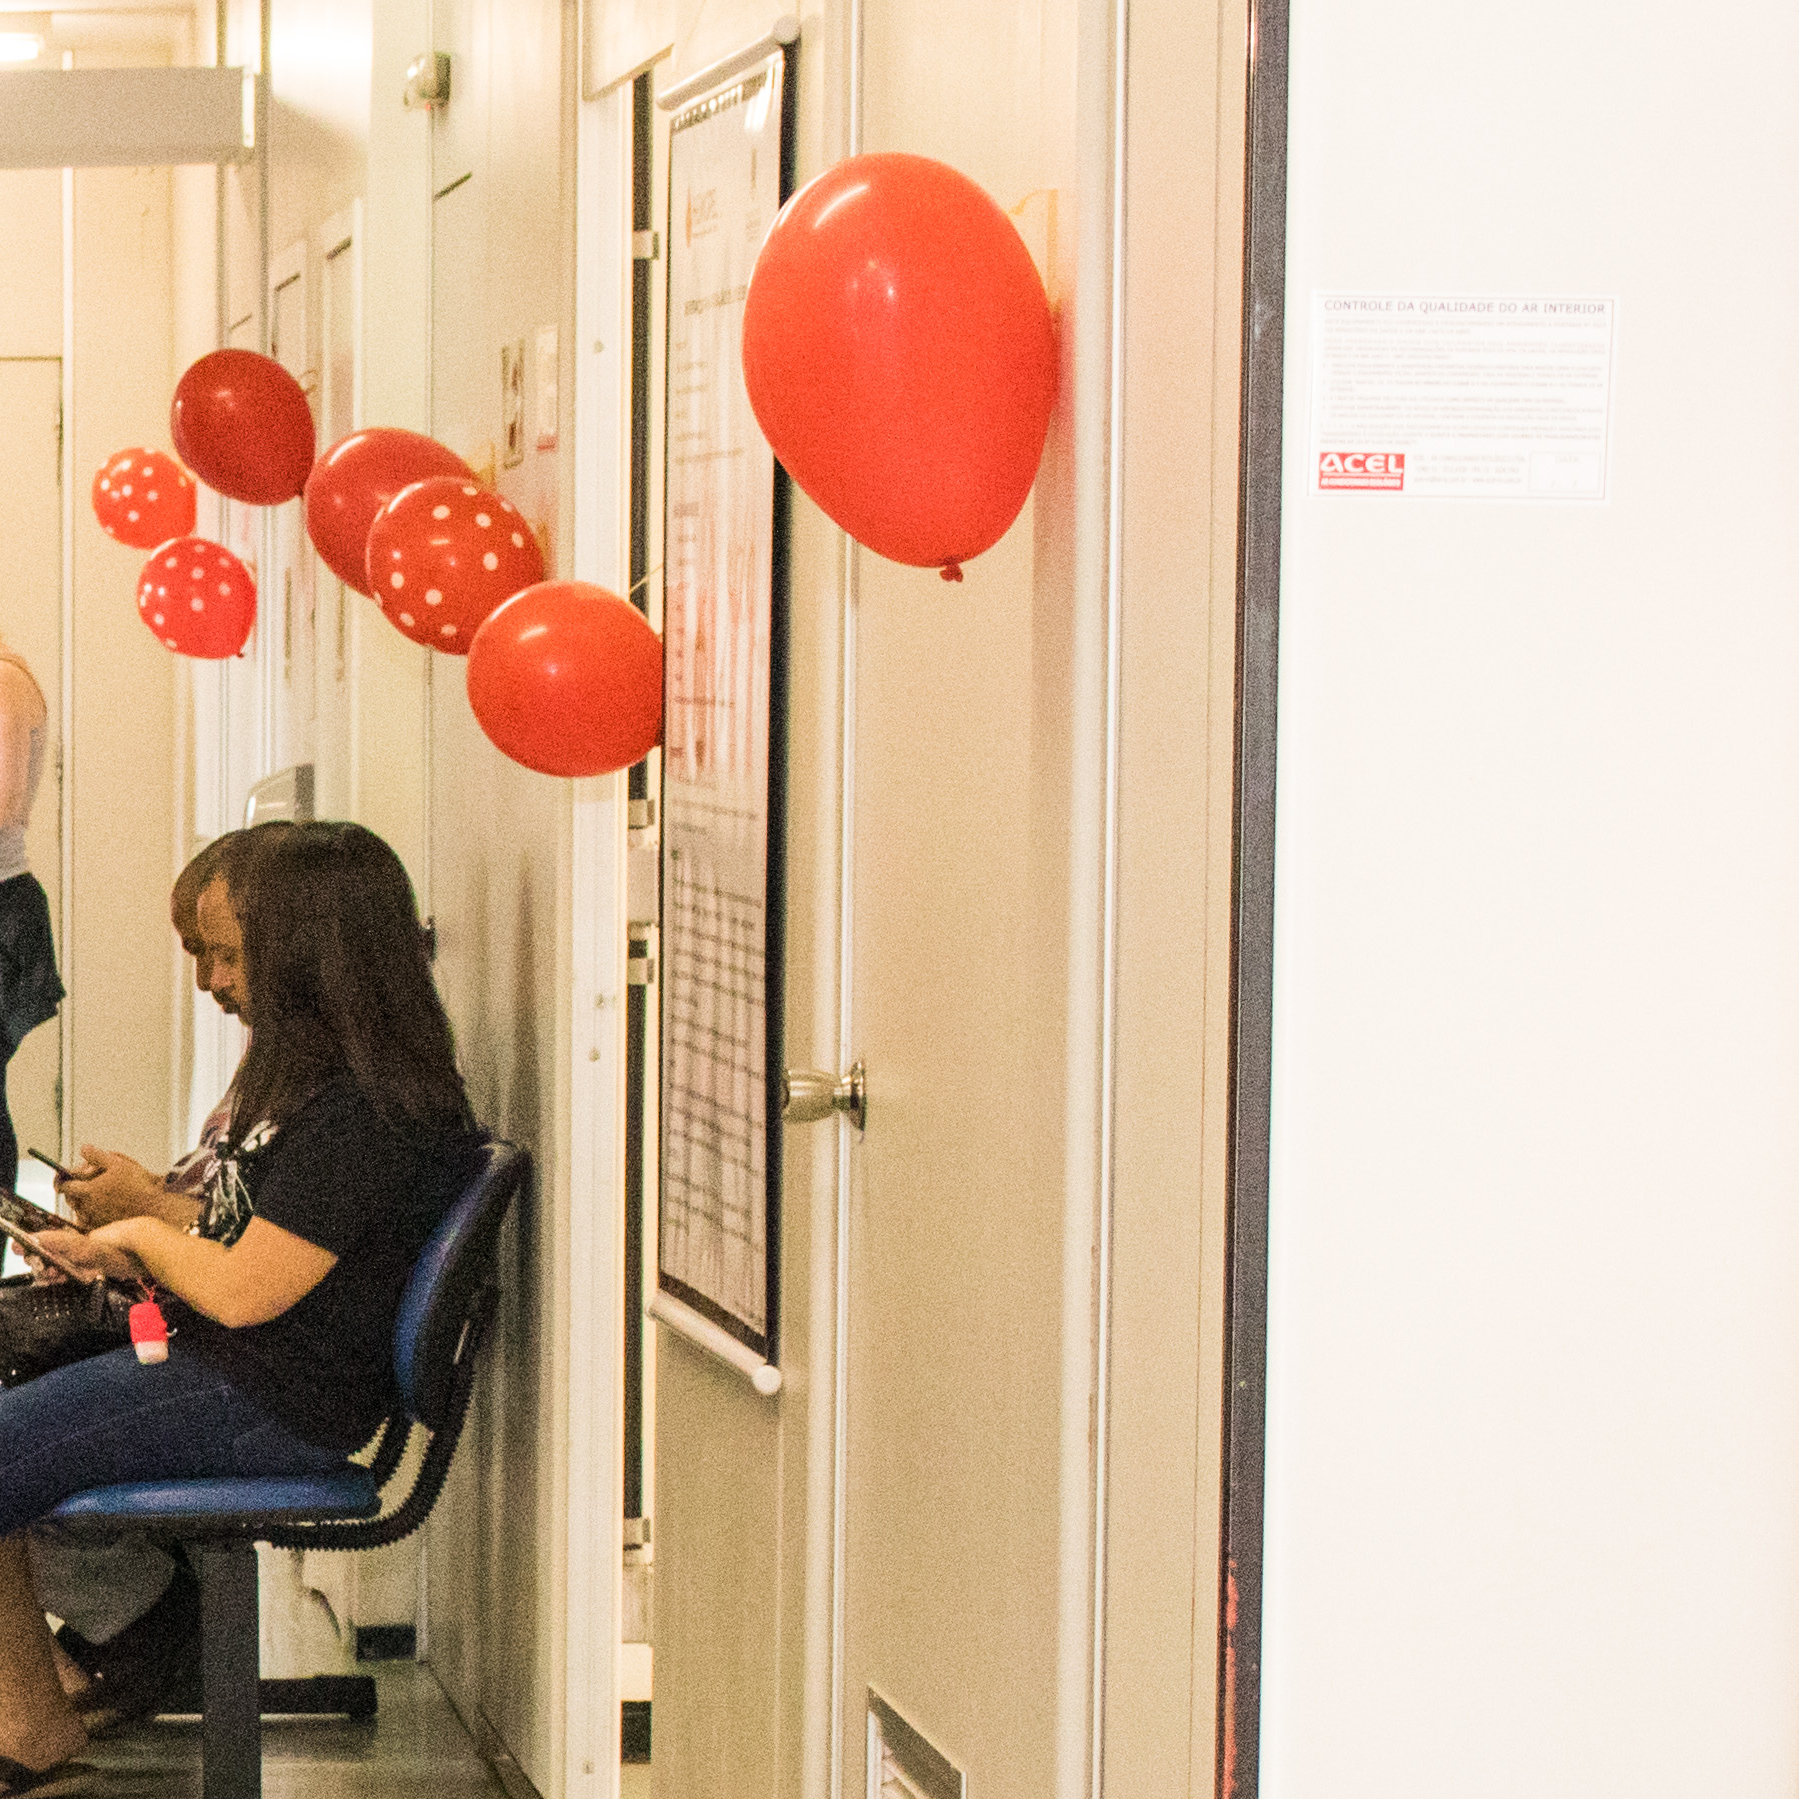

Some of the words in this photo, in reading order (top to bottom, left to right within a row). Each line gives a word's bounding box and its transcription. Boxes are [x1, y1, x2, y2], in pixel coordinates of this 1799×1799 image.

[1324, 300, 1393, 311] CONTROLE
[1397, 301, 1415, 312] DA
[1419, 301, 1495, 314] QUALIDADE
[1498, 302, 1517, 313] DO
[1522, 302, 1538, 313] AR
[1543, 302, 1606, 314] INTERIOR
[1320, 453, 1403, 474] ACEL
